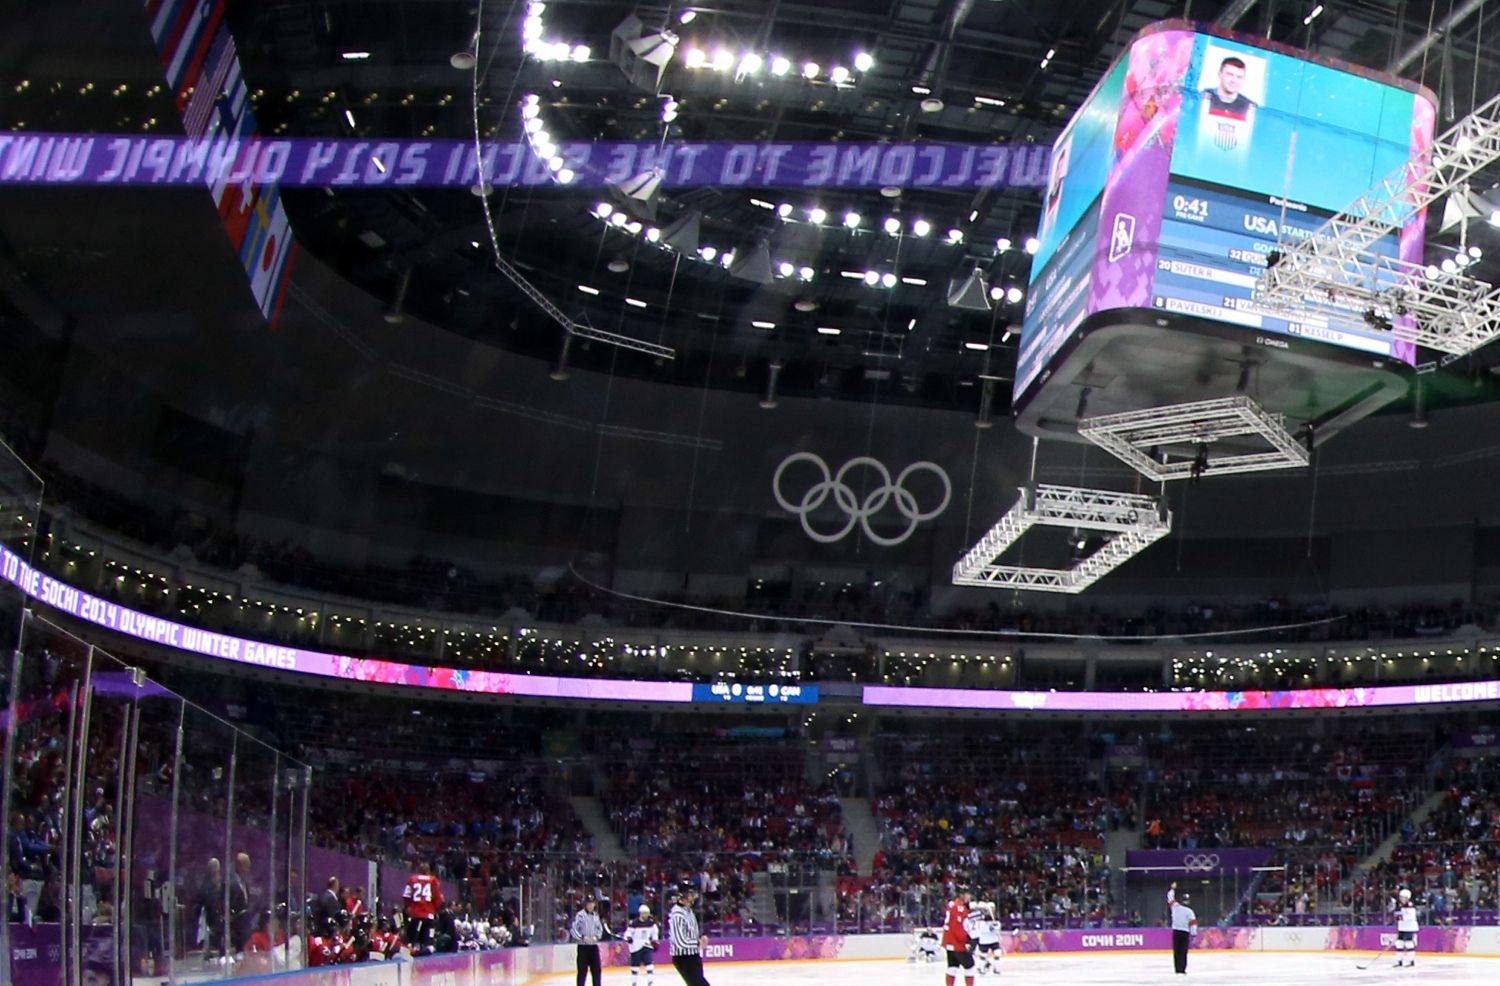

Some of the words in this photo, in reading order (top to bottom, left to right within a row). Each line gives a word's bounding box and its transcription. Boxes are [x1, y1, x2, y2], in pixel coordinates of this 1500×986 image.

[1173, 195, 1209, 217] 0:41
[1244, 214, 1278, 236] USA
[1158, 260, 1171, 271] 20
[1174, 263, 1205, 277] SUTER
[1223, 297, 1237, 309] 21
[2, 549, 19, 582] TO
[19, 561, 40, 597] THE
[40, 577, 79, 614] SOCHI
[80, 594, 118, 628] 2014
[119, 608, 180, 646] OLYMPIC
[182, 627, 240, 660] WINTER
[244, 641, 297, 669] GAMES
[1414, 682, 1497, 703] WELCOME
[412, 882, 433, 902] 24
[705, 944, 733, 957] 2014
[1082, 935, 1114, 947] СОЧИ
[1115, 934, 1143, 946] 2014
